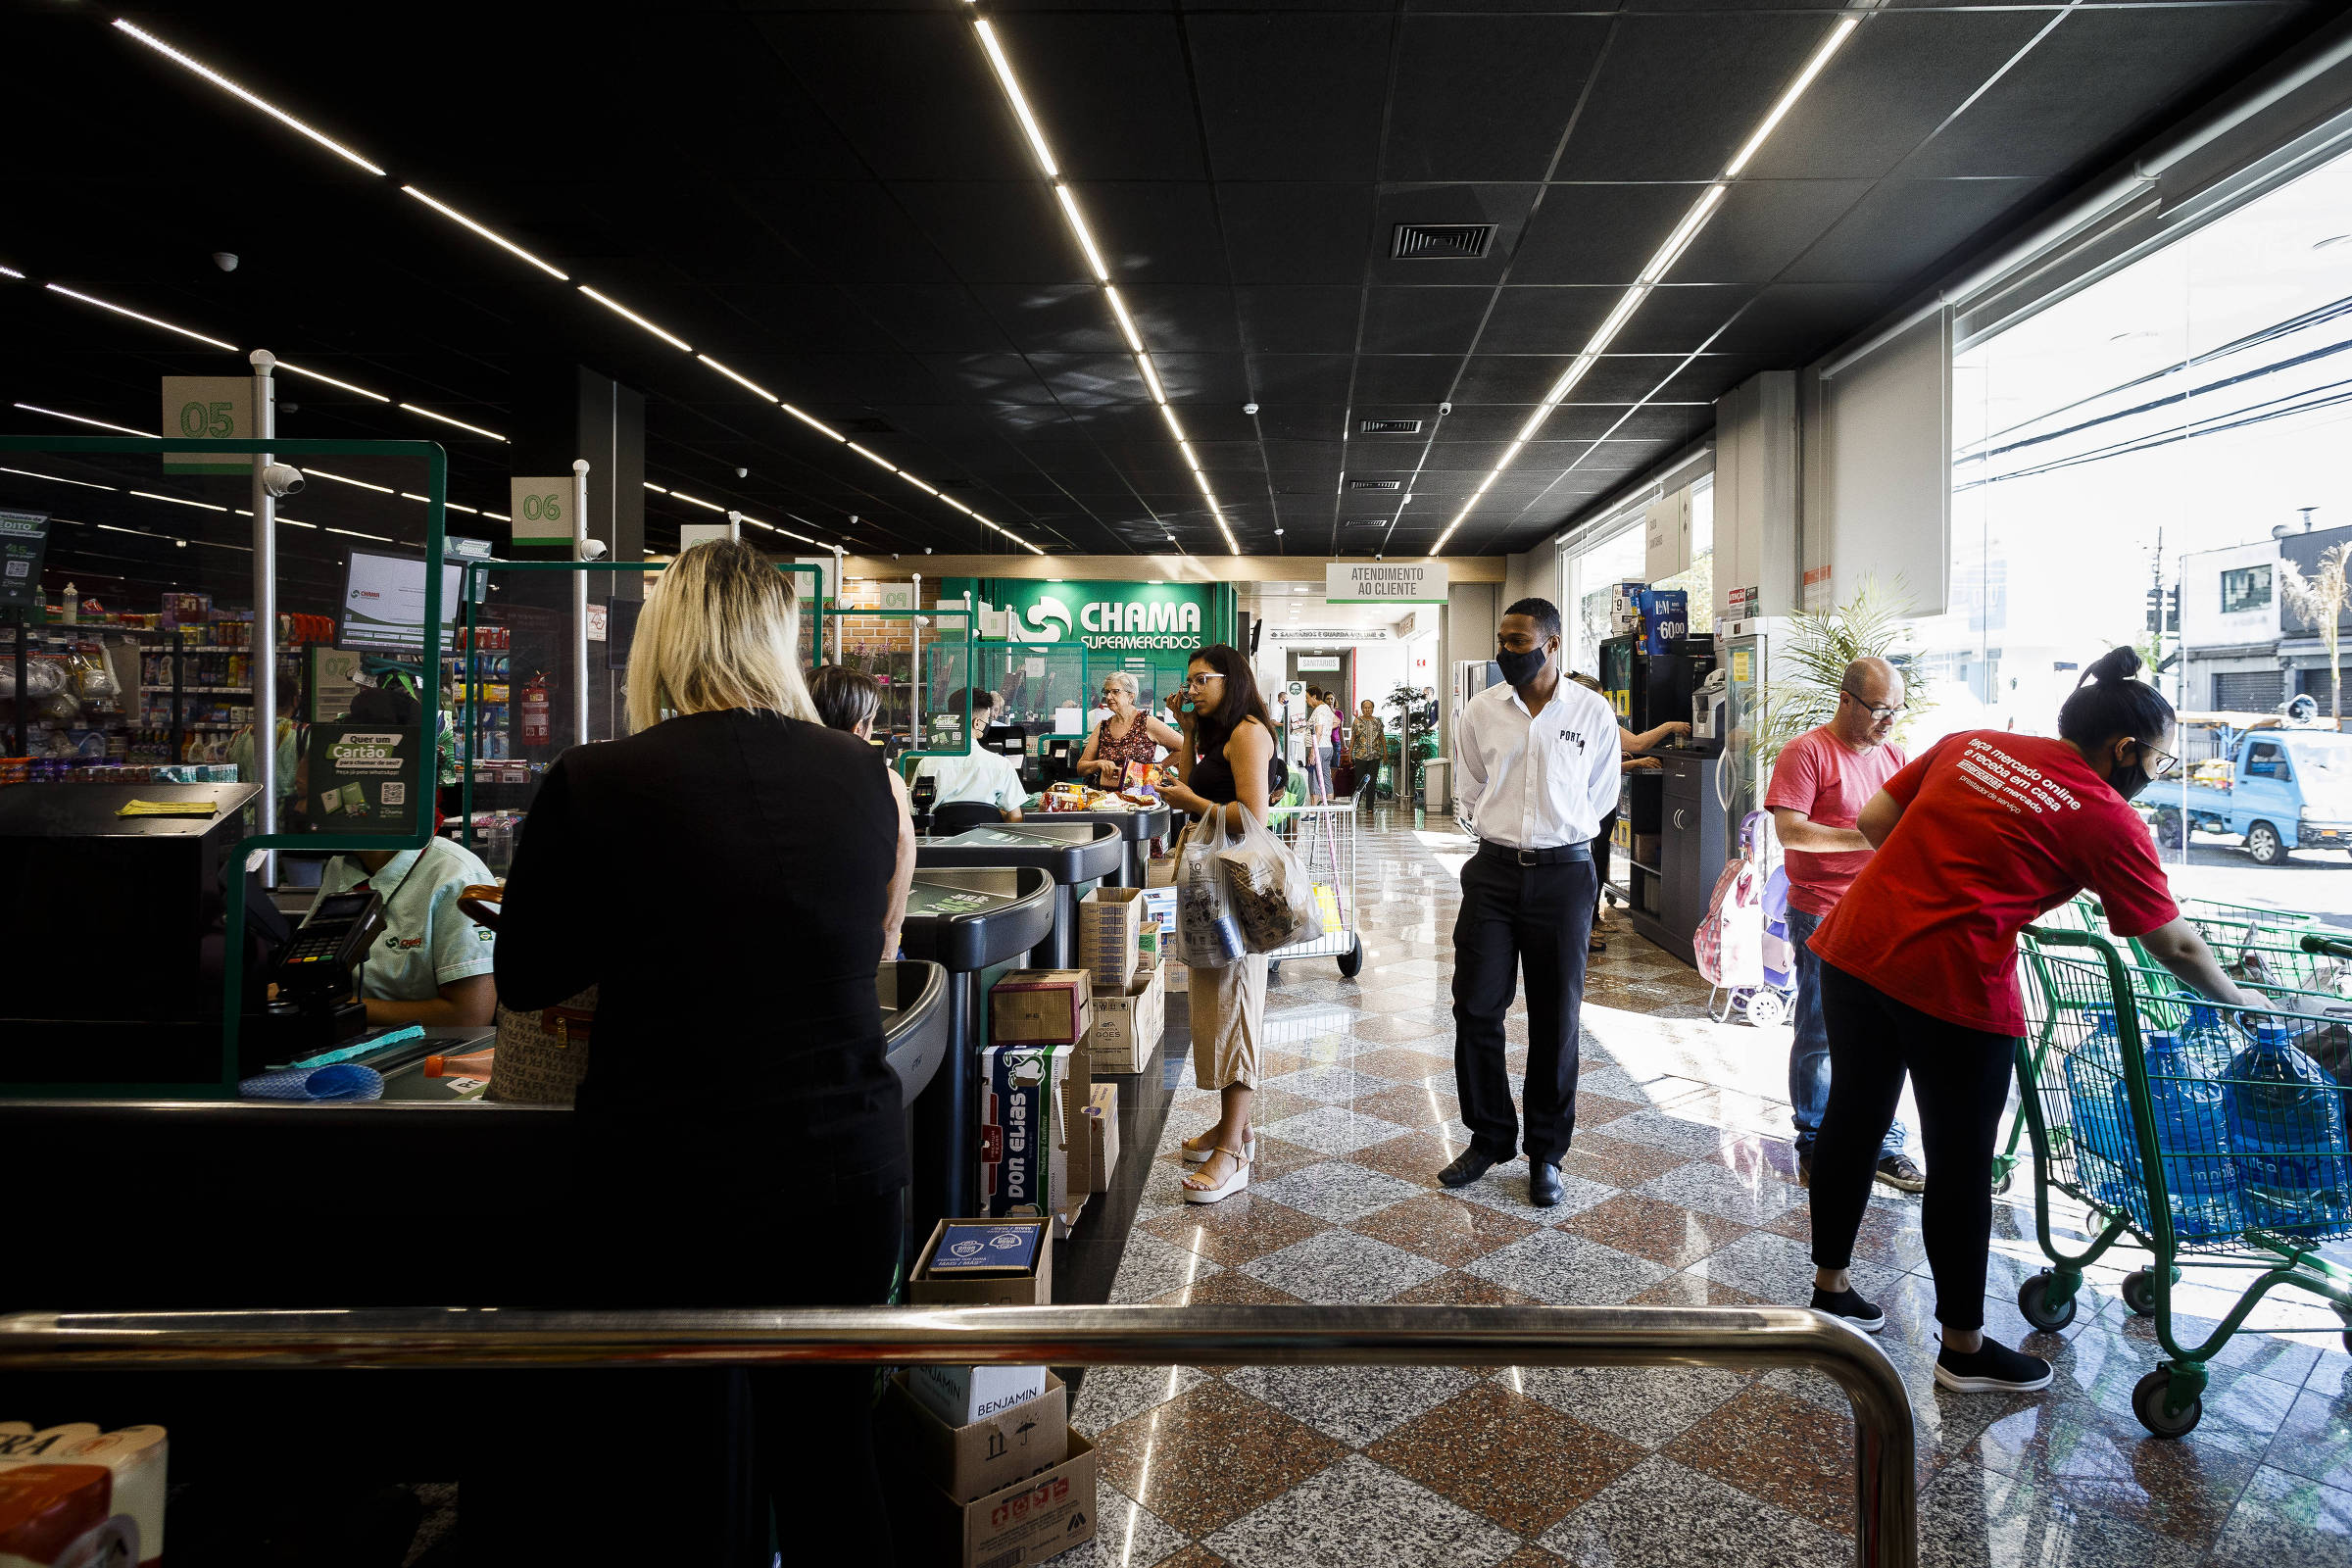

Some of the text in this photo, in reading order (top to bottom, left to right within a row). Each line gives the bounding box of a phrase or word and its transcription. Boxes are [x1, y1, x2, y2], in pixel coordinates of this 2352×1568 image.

[180, 402, 234, 439] 05
[523, 494, 563, 521] 06
[1351, 567, 1424, 581] ATENDIMENTO
[1358, 582, 1417, 596] AO CLIENTE
[1080, 602, 1200, 633] CHAMA
[1081, 635, 1201, 650] SUPERMERCADOS
[1302, 658, 1337, 667] SANITÁRIOS
[333, 745, 386, 759] Cartão
[350, 735, 374, 744] Quer
[1968, 738, 2082, 810] faça mercado online
[1972, 753, 2011, 778] receba
[2009, 775, 2032, 790] em
[2031, 787, 2061, 812] casa
[1959, 775, 2022, 814] prestador de serviço
[1007, 1156, 1025, 1199] DON
[977, 1386, 1038, 1417] BENJAMIN
